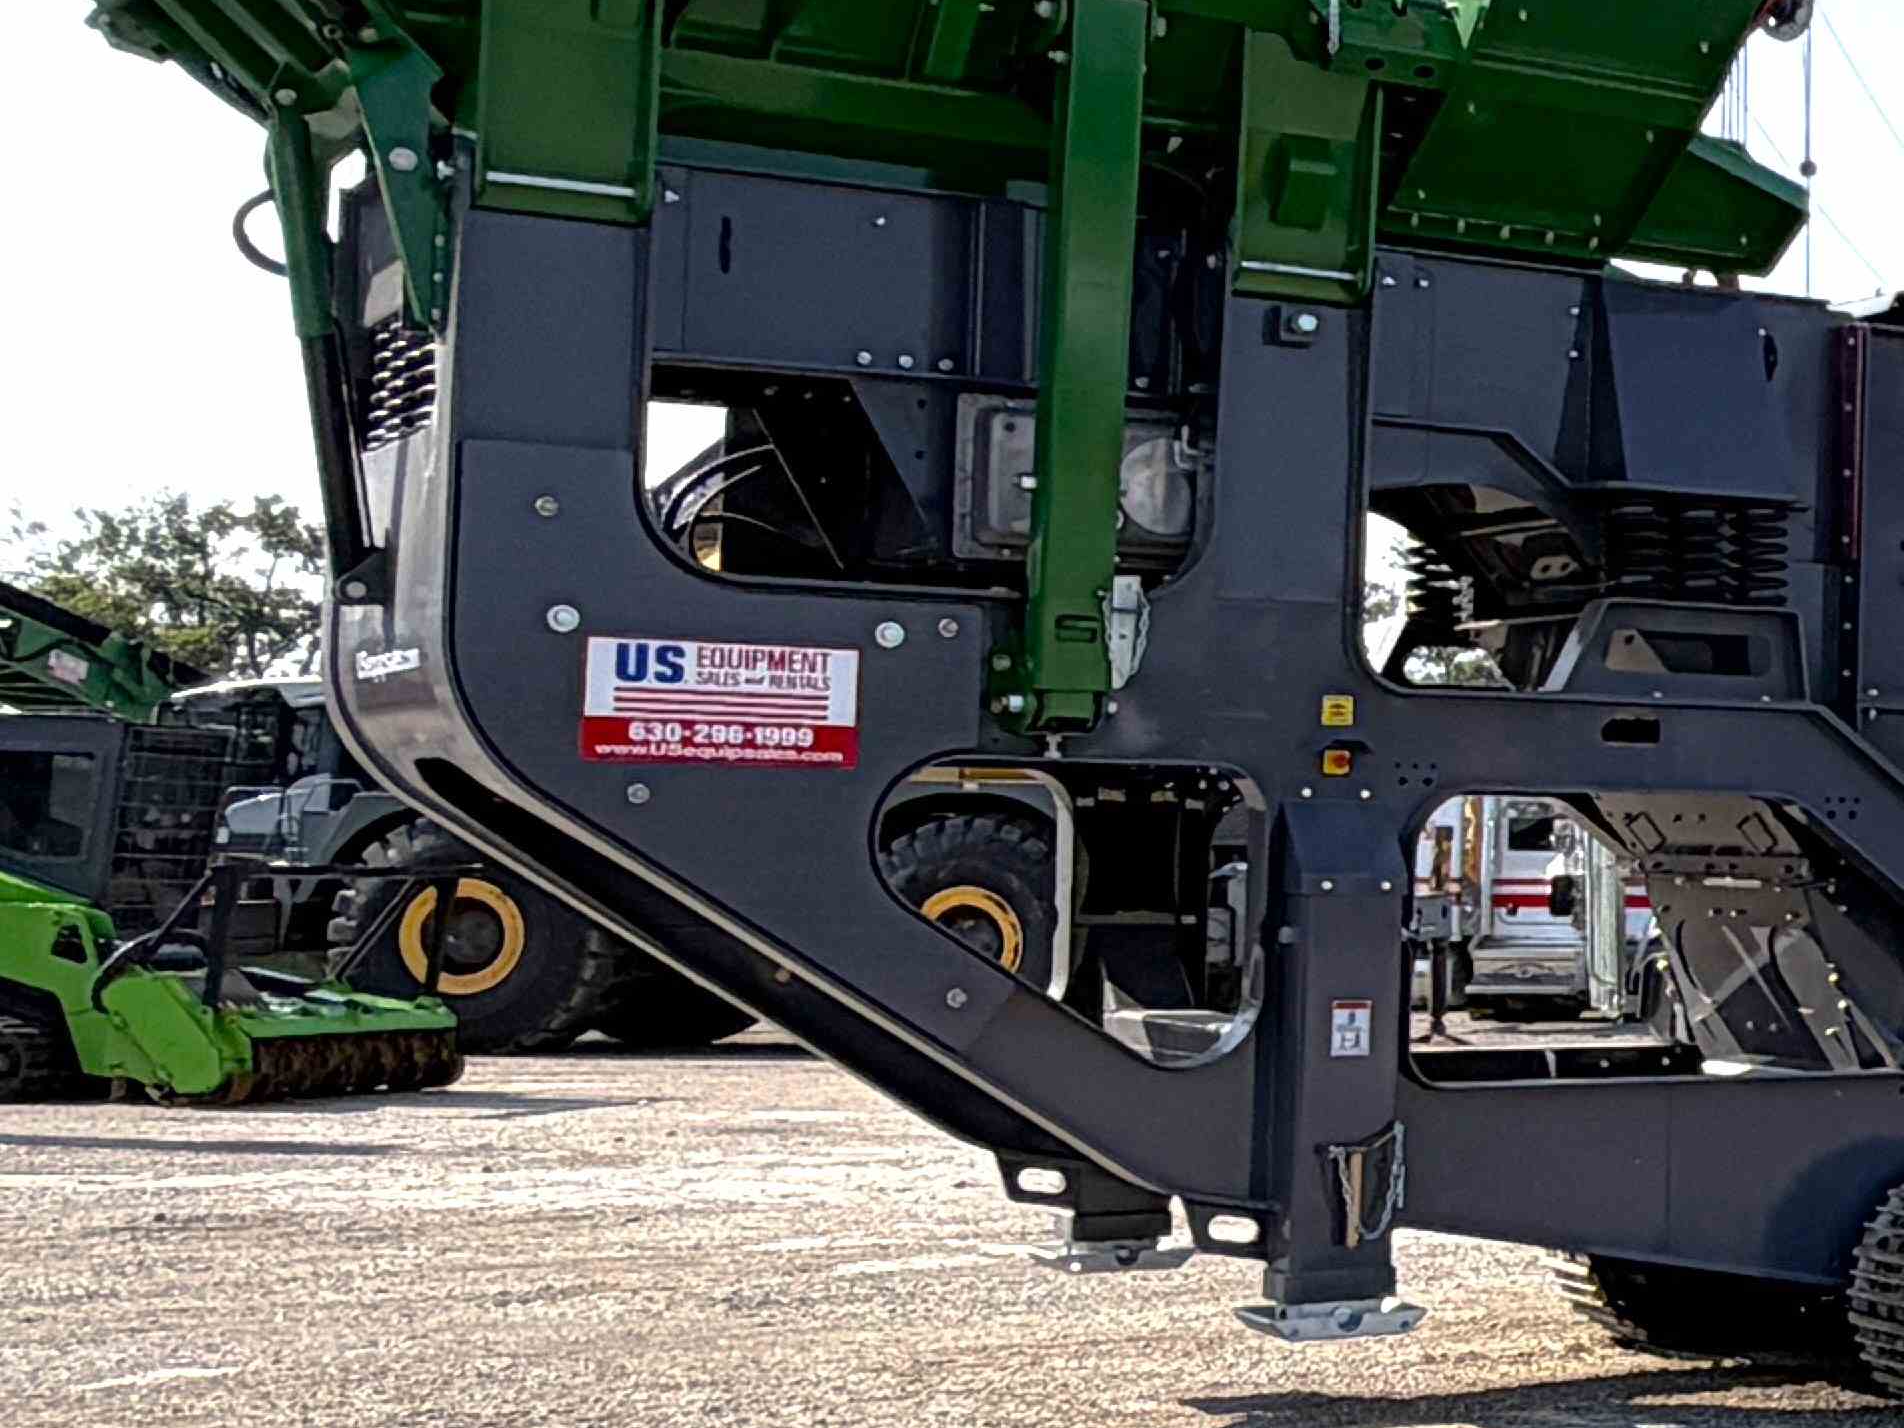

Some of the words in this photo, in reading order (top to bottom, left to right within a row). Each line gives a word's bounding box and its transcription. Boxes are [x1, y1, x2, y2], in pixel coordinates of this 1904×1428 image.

[696, 644, 832, 675] EQUIPMENT
[696, 670, 740, 686] SALES
[768, 674, 831, 692] RENTALS
